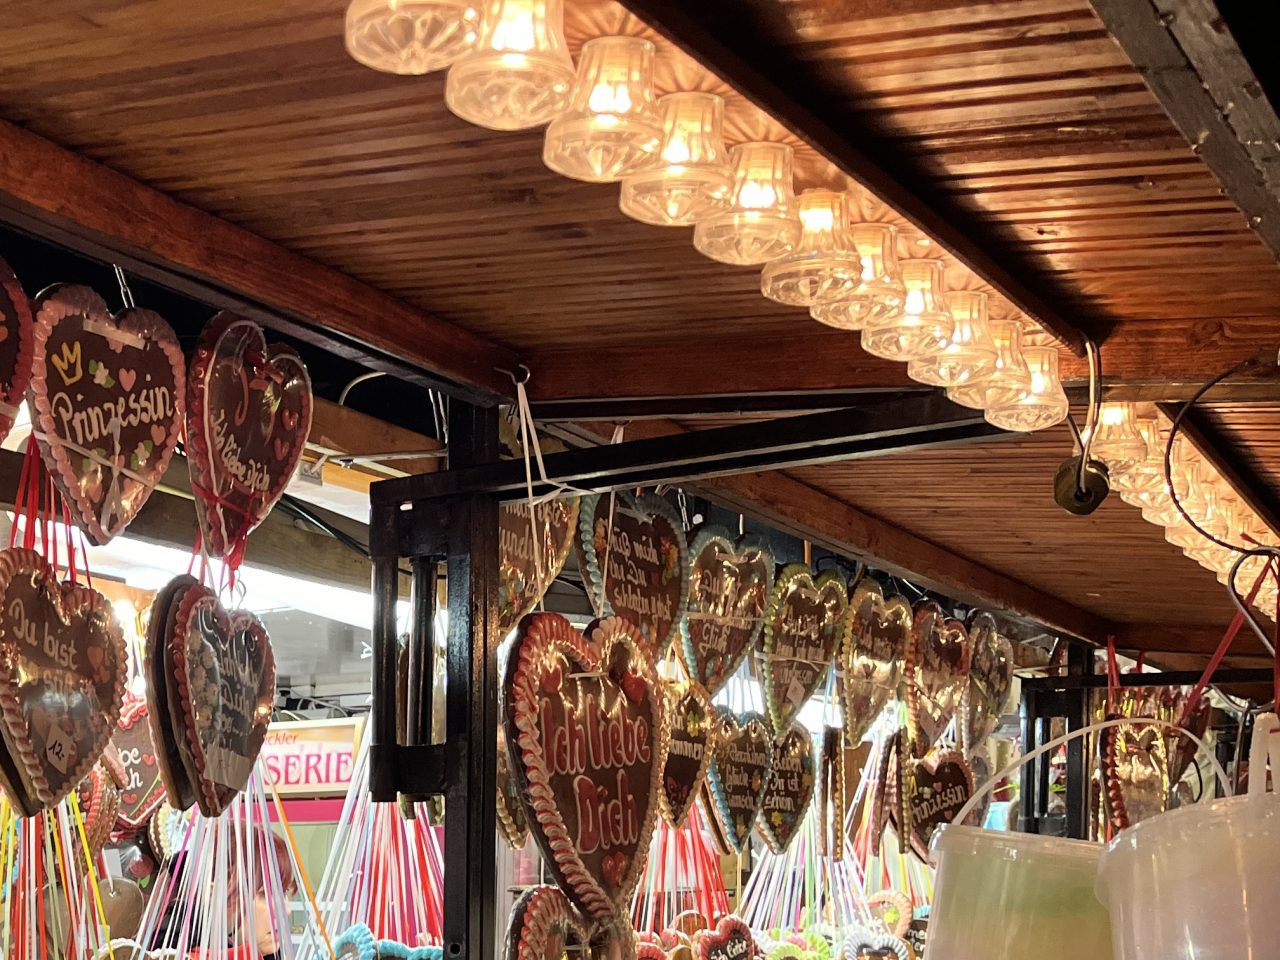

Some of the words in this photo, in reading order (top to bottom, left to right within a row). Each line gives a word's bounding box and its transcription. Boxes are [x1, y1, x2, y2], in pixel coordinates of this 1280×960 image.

[51, 383, 176, 446] Prinzessin
[9, 597, 37, 648] Du
[43, 622, 78, 671] bist
[540, 696, 586, 776] Ich
[587, 692, 651, 771] liebe
[574, 768, 639, 854] Dich
